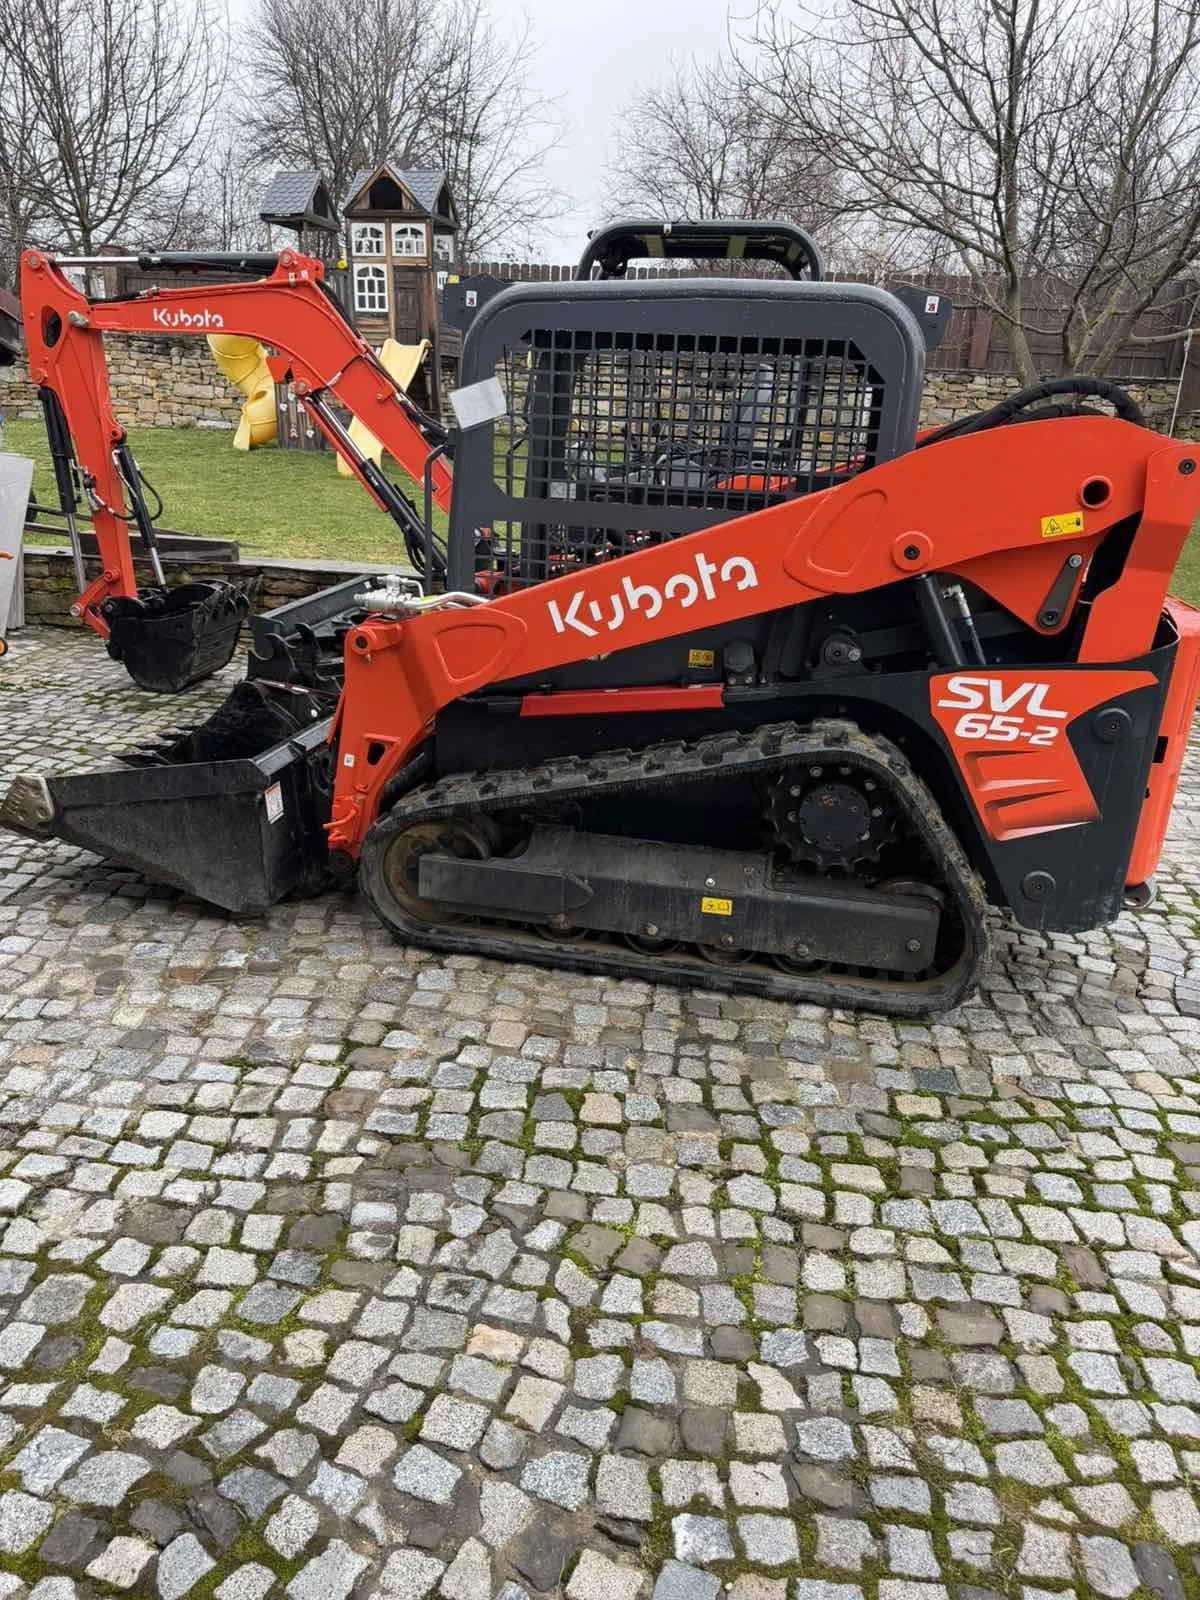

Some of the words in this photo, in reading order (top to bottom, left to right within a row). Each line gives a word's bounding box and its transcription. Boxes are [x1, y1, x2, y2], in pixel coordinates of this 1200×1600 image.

[153, 308, 224, 328] Kubota
[547, 552, 759, 637] Kubota
[937, 676, 1069, 719] SVL
[954, 712, 1059, 746] 65-2
